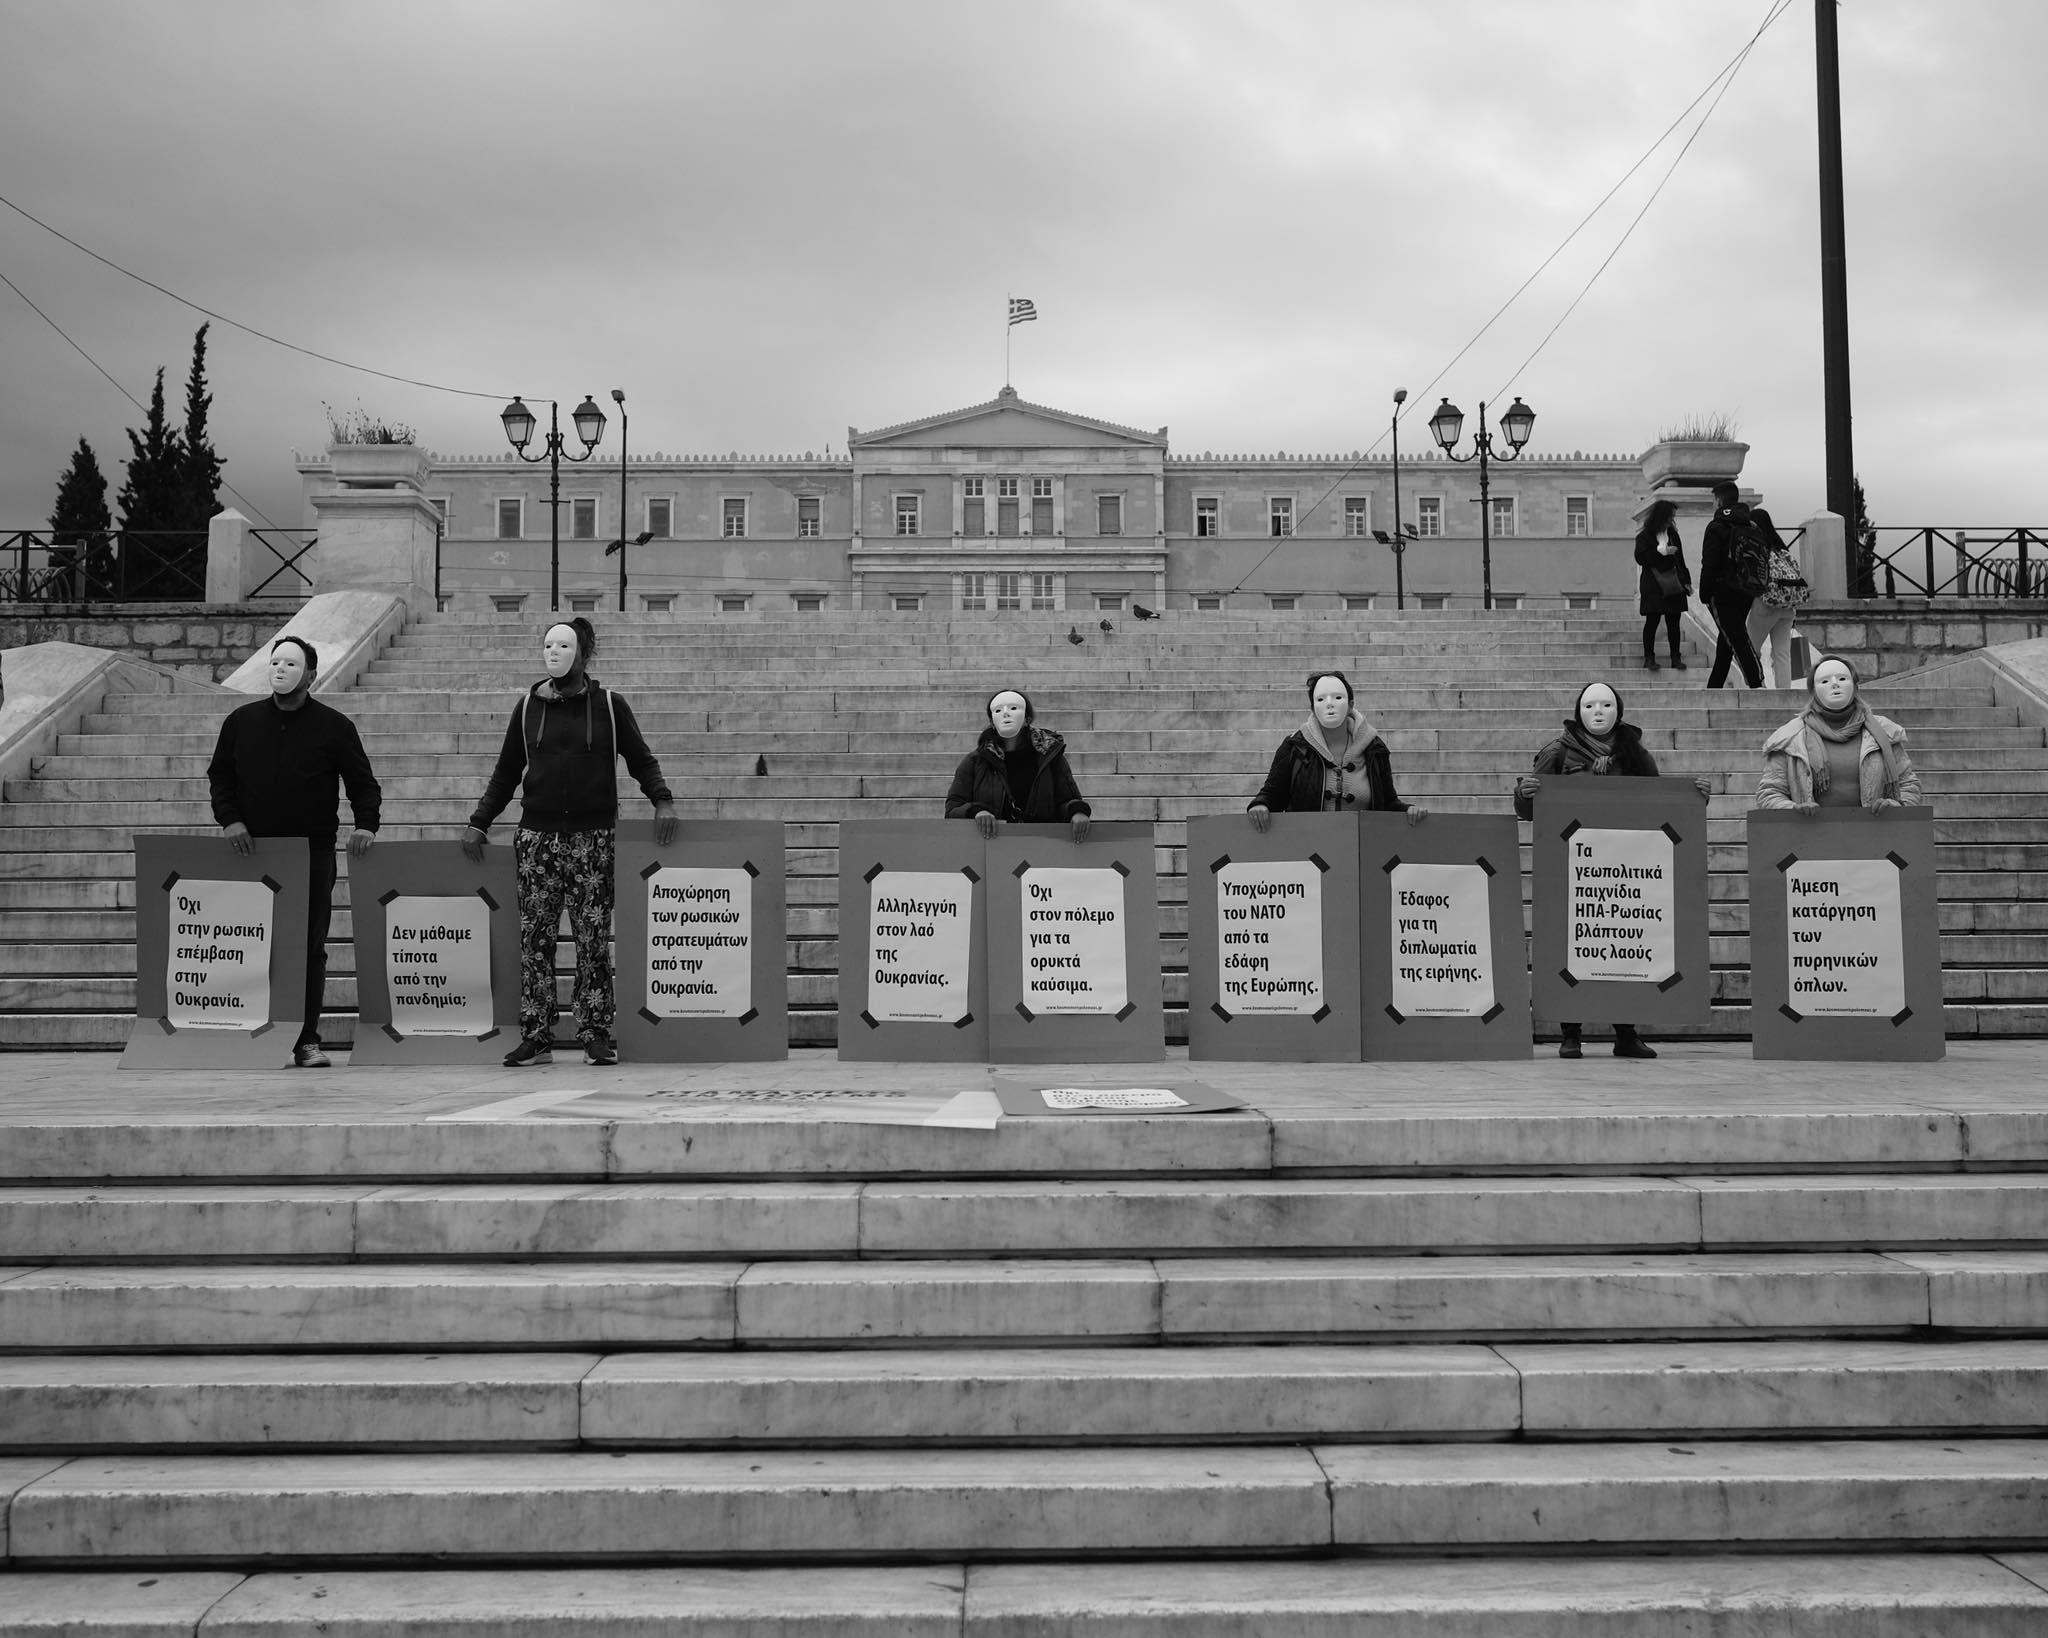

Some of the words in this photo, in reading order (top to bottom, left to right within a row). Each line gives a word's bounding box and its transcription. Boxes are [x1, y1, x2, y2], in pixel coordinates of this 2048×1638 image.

[1576, 843, 1592, 857] Τα
[1576, 864, 1662, 880] γεωπολιτικά
[653, 885, 730, 903] Αποχώρηση
[1029, 884, 1052, 901] Όχι
[1223, 881, 1304, 899] Υποχώρηση
[1576, 884, 1641, 902] παιχνίδια
[1791, 879, 1838, 896] Άμεση
[177, 897, 200, 915] Όχι
[877, 898, 956, 917] Αλληλεγγύη
[1399, 891, 1449, 910] Έδαφος
[652, 912, 678, 922] των
[681, 909, 739, 926] ρωσικών
[1030, 911, 1061, 921] στον
[1065, 907, 1114, 925] πόλεμο
[1224, 909, 1246, 920] του
[1251, 905, 1285, 919] NATO
[1576, 903, 1661, 921] ΗΠΑ-Ρωσίας
[1793, 903, 1876, 921] κατάργηση
[178, 924, 210, 938] στην
[214, 923, 264, 941] ρωσική
[392, 926, 416, 939] Δεν
[420, 926, 471, 943] μάθαμε
[877, 926, 907, 936] στον
[910, 922, 934, 936] λαό
[1399, 919, 1419, 933] για
[1422, 920, 1437, 934] τη
[1576, 923, 1643, 941] βλάπτουν
[652, 932, 747, 950] στρατευμάτων
[1030, 934, 1051, 947] για
[1055, 934, 1070, 944] τα
[1225, 929, 1250, 944] από
[1253, 933, 1268, 943] τα
[1792, 932, 1821, 942] των
[177, 945, 243, 964] επέμβαση
[393, 949, 437, 963] τίποτα
[876, 949, 897, 963] της
[1400, 940, 1477, 958] διπλωματία
[1575, 947, 1606, 960] τους
[1610, 944, 1652, 962] λαούς
[652, 956, 677, 970] από
[680, 960, 702, 974] την
[1031, 954, 1080, 971] ορυκτά
[1225, 954, 1268, 971] εδάφη
[1793, 953, 1877, 971] πυρηνικών
[175, 972, 207, 987] στην
[394, 972, 420, 985] από
[423, 976, 446, 988] την
[876, 970, 948, 987] Ουκρανίας.
[1400, 968, 1422, 982] της
[1426, 965, 1481, 982] ειρήνης.
[652, 980, 717, 998] Ουκρανία.
[1032, 977, 1092, 994] καύσιμα.
[1225, 982, 1247, 996] της
[1252, 978, 1318, 996] Ευρώπης.
[1794, 977, 1847, 992] όπλων.
[176, 992, 244, 1010] Ουκρανία.
[396, 993, 466, 1008] πανδημία;
